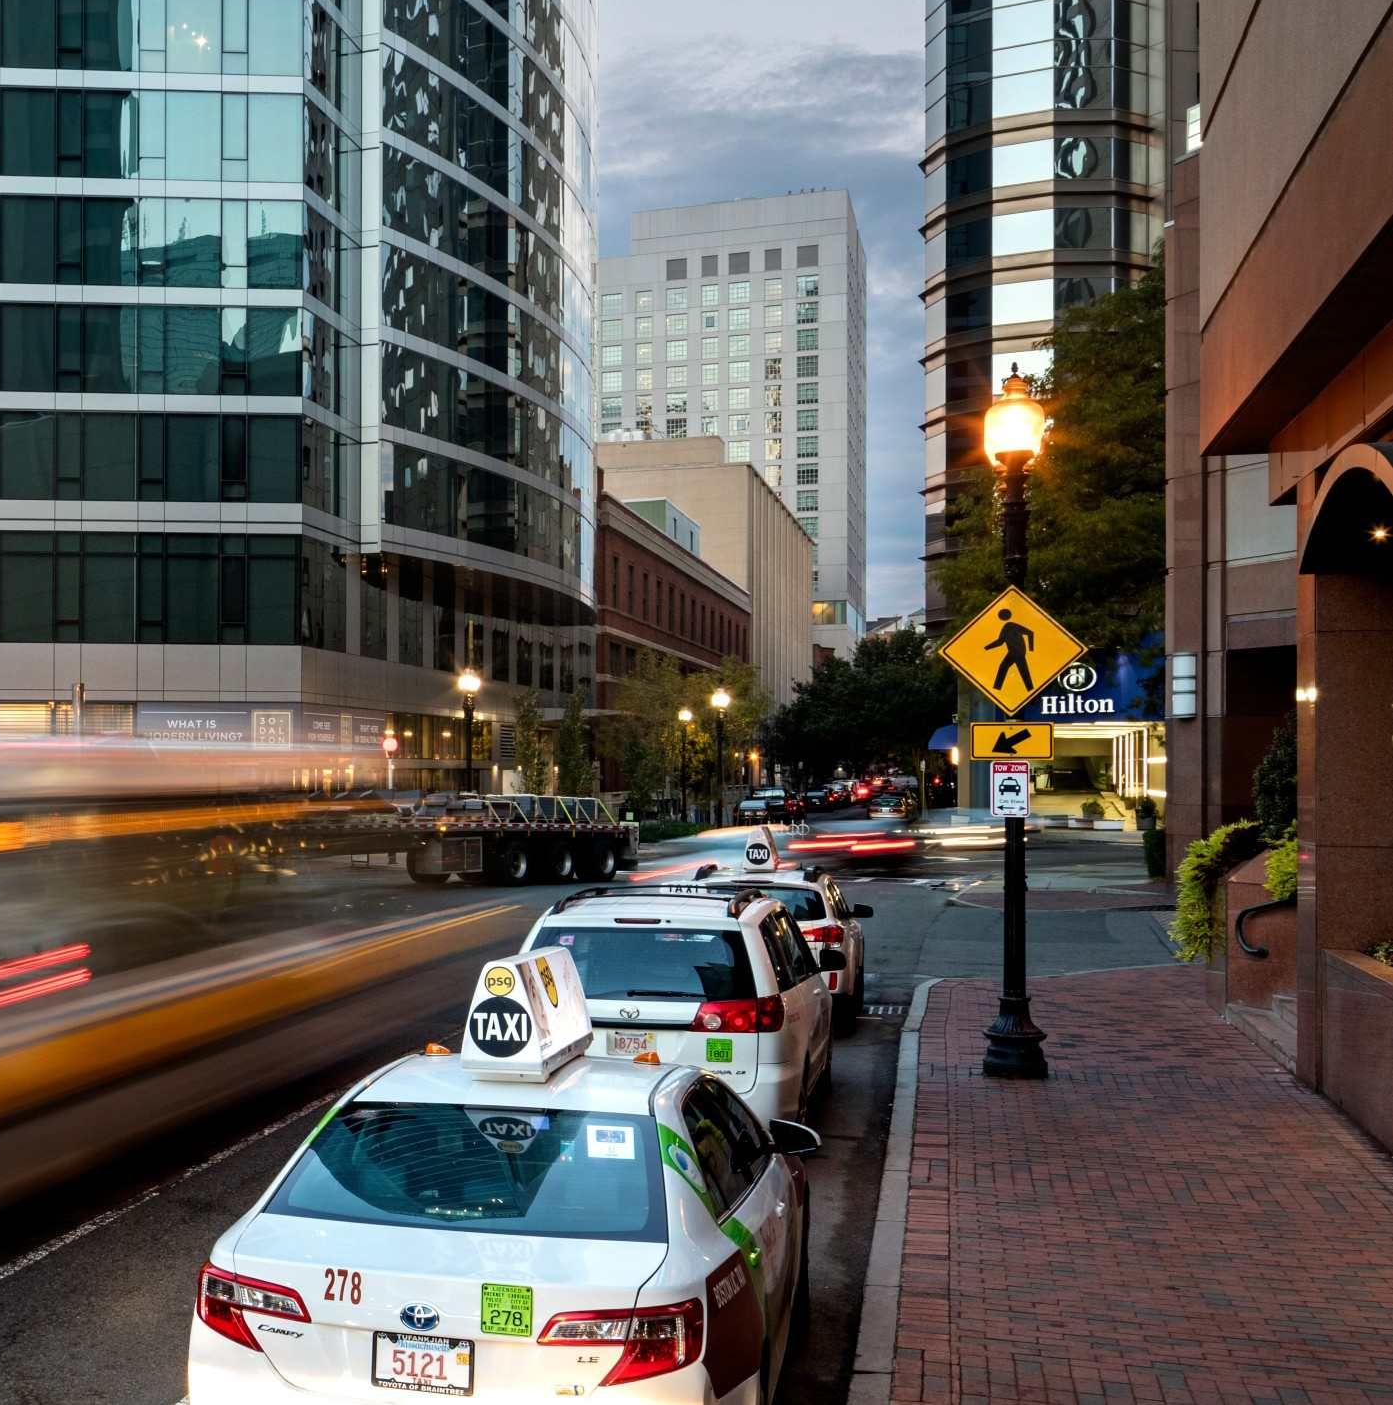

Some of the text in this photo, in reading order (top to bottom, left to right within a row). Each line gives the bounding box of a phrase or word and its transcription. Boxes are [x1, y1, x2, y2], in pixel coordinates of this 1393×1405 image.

[1041, 694, 1115, 715] Hilton
[167, 719, 217, 729] WHAT IS
[198, 732, 243, 741] LIVING?
[259, 727, 285, 735] DAL
[1010, 764, 1028, 772] ZONE
[748, 848, 768, 860] TAXI
[669, 884, 699, 893] TAXI
[473, 1012, 528, 1042] TAXI
[709, 1050, 729, 1058] 1801
[324, 1267, 362, 1305] 278
[490, 1309, 523, 1327] 278
[257, 1324, 304, 1338] CAMRY
[396, 1334, 450, 1344] TUFANKJIAN
[392, 1349, 448, 1380] 5121
[378, 1381, 407, 1390] TOYOTA
[421, 1386, 465, 1396] BRAINTREE
